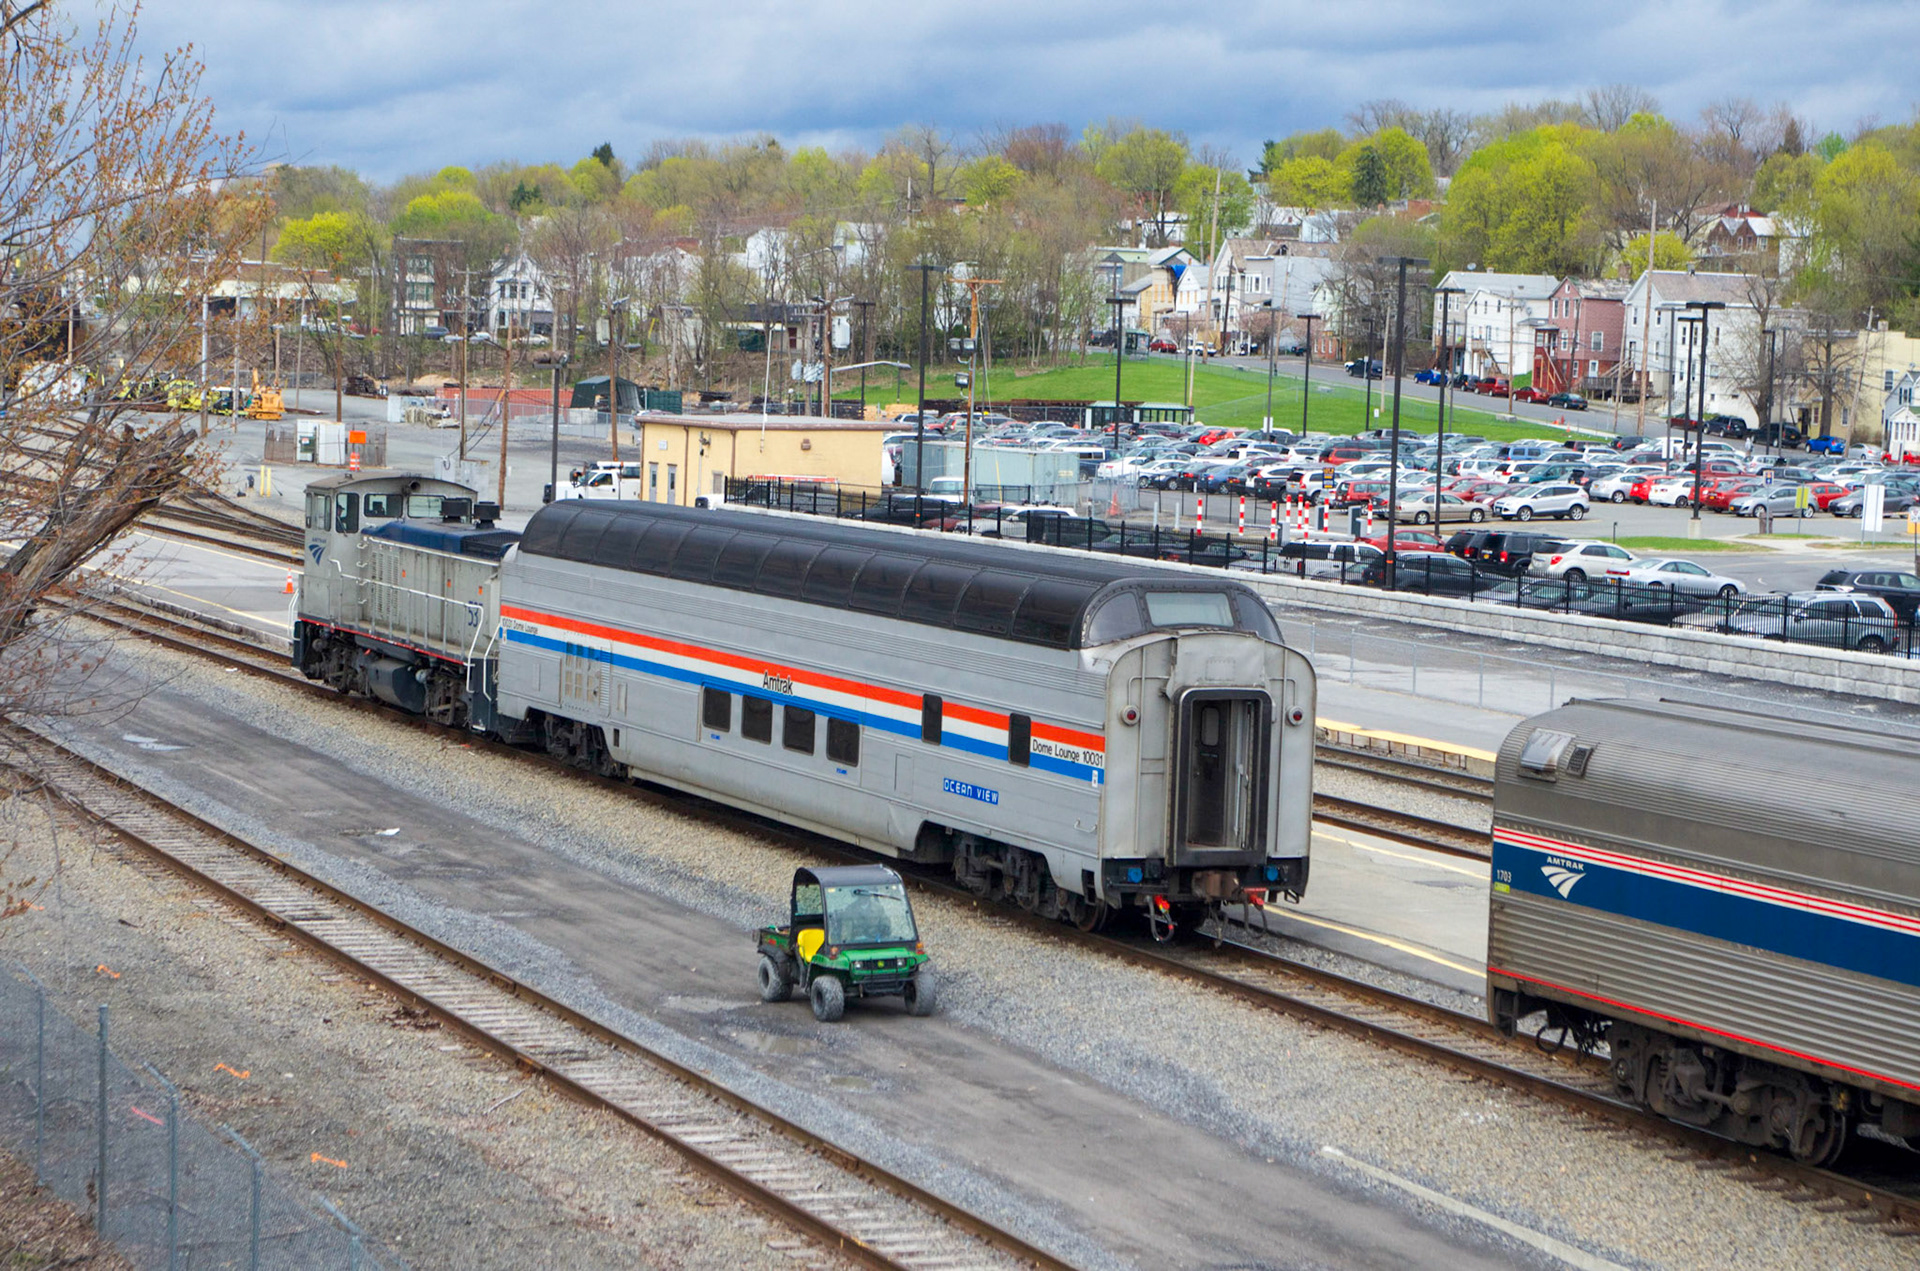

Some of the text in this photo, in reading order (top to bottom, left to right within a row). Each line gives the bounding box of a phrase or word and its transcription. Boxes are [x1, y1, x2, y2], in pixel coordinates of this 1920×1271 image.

[763, 669, 793, 695] Amtrak
[1032, 739, 1103, 768] Dome Lounge 10031
[944, 779, 998, 803] OCEAN VIEW
[1547, 856, 1585, 871] AMTRAK
[1496, 869, 1512, 883] 1703
